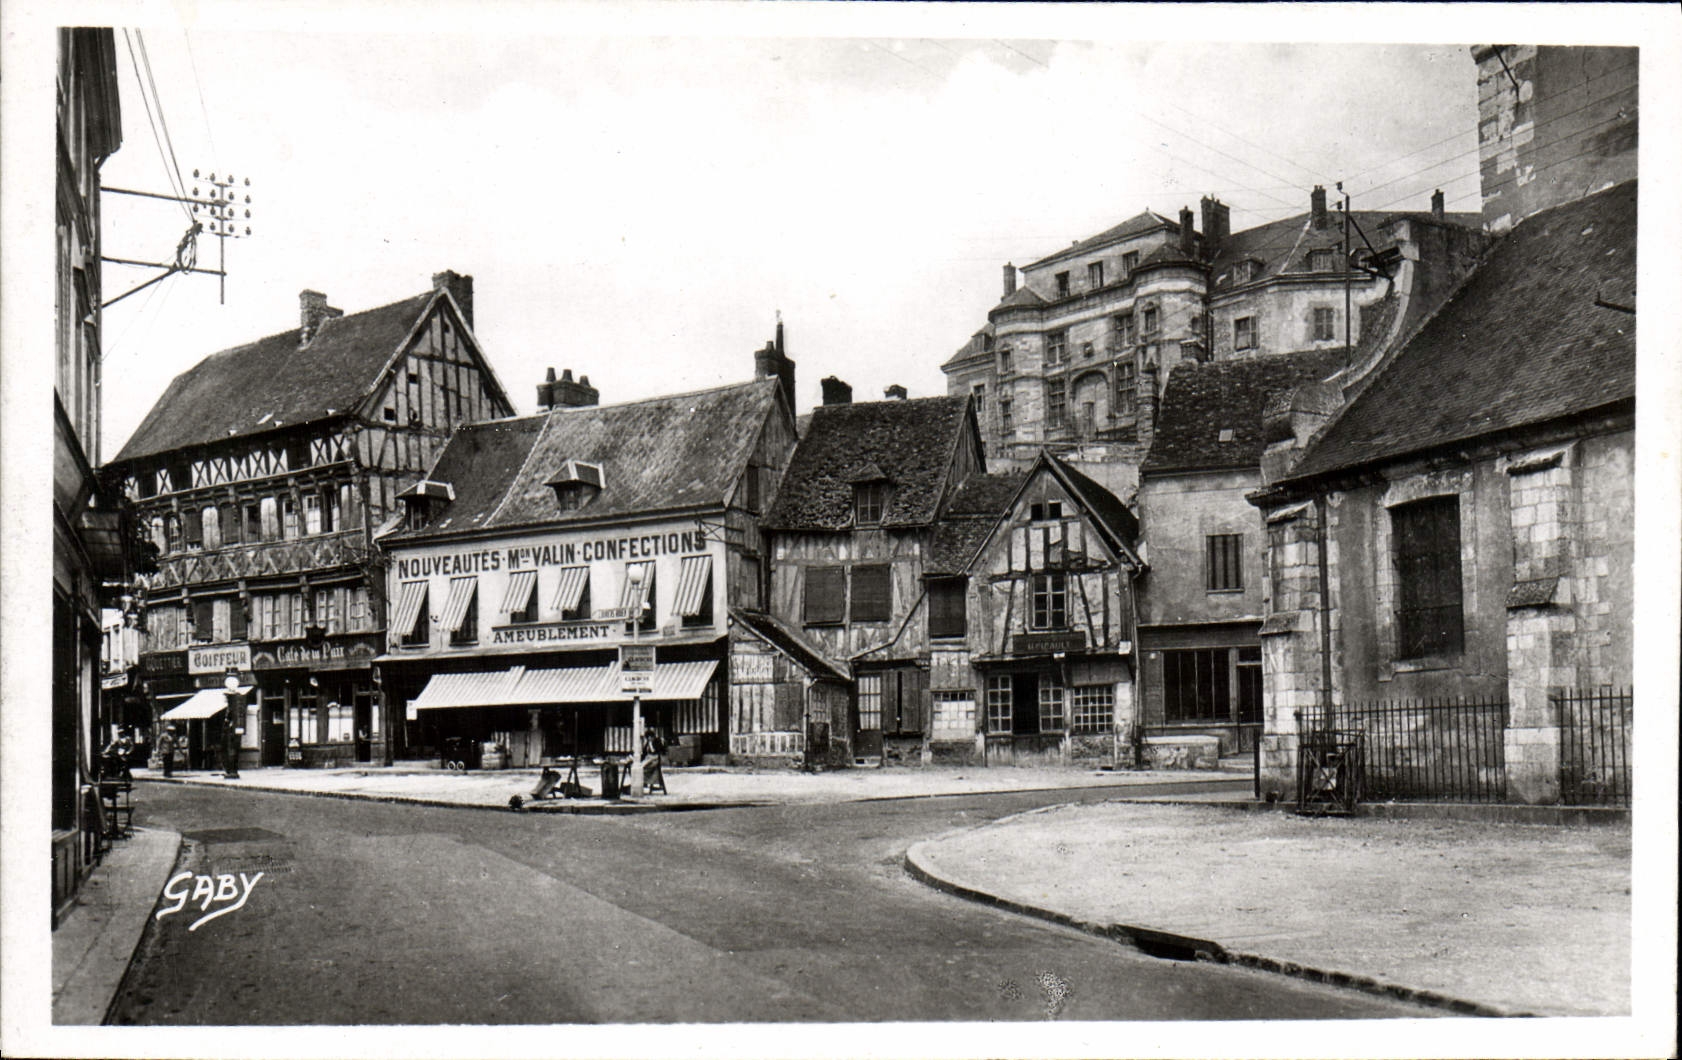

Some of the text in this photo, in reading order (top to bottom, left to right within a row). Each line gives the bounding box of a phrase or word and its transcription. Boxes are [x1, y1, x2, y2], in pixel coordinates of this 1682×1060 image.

[532, 543, 575, 567] VALIN
[583, 531, 707, 562] CONFECTIONS
[492, 625, 610, 644] AMEUBLEMENT
[193, 650, 247, 668] COIFFEUR
[300, 645, 311, 661] de
